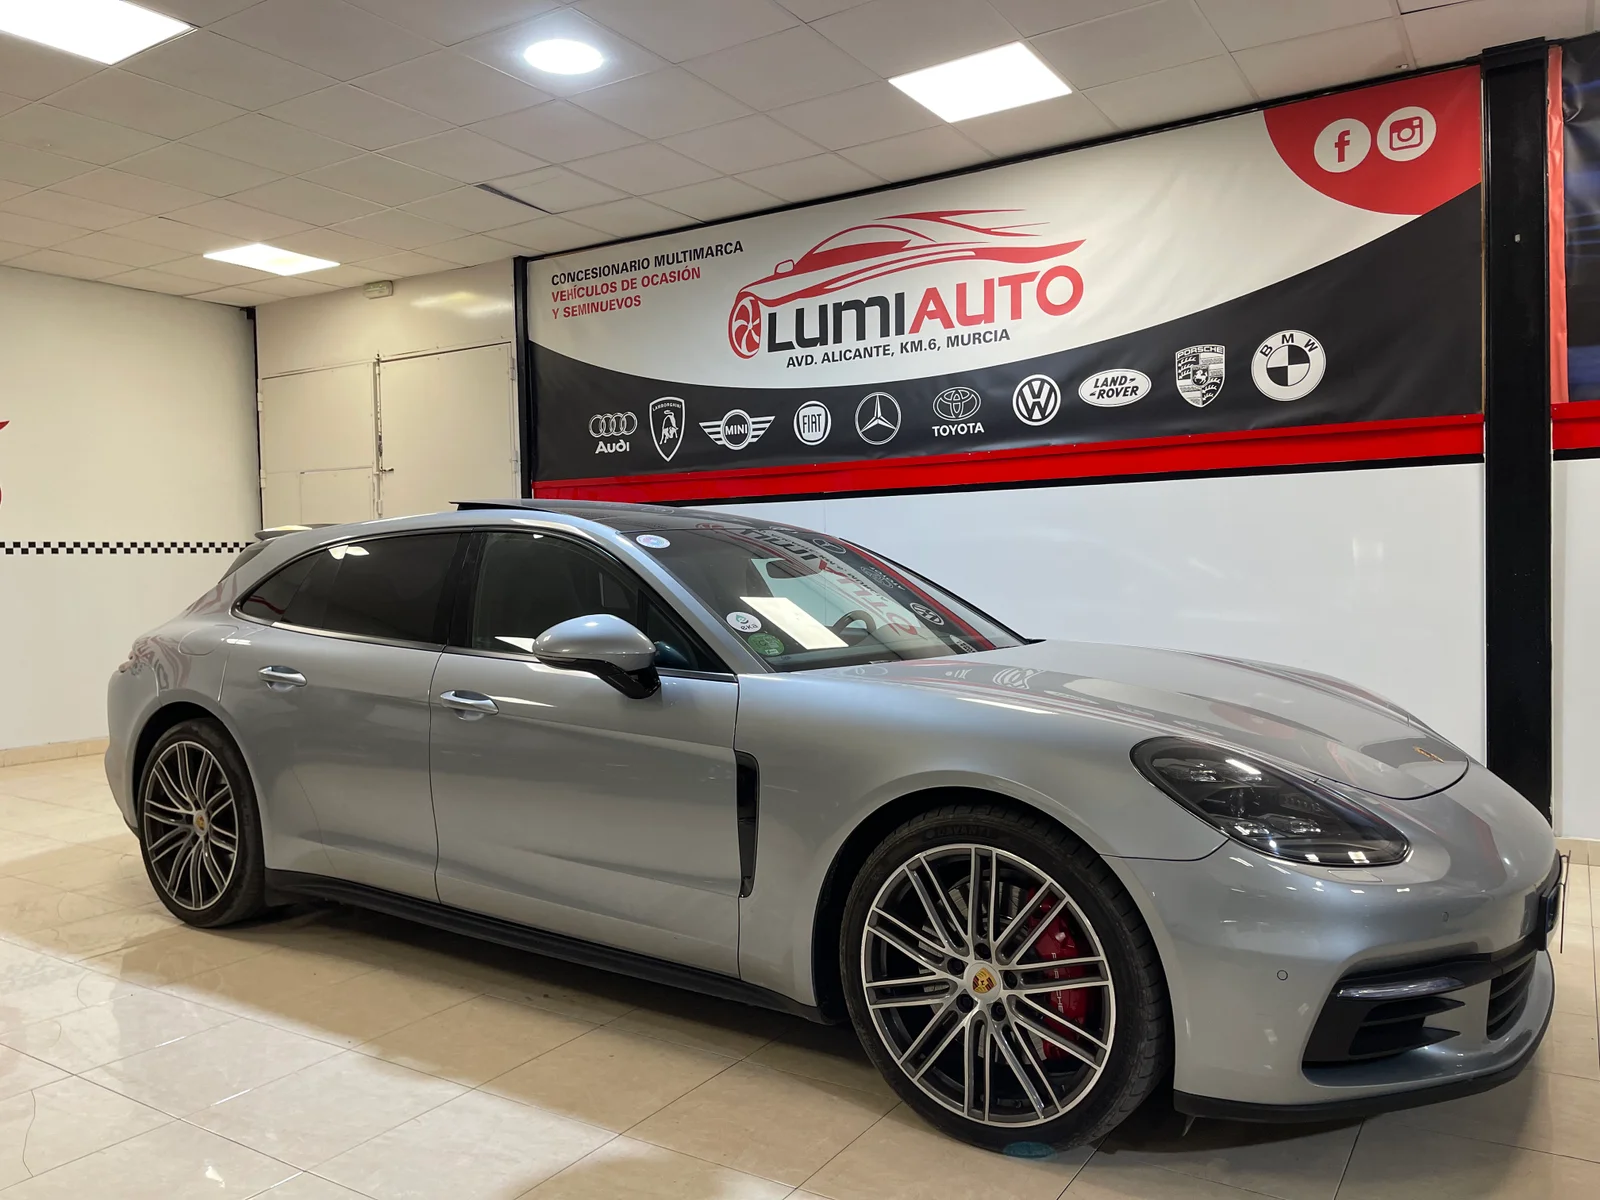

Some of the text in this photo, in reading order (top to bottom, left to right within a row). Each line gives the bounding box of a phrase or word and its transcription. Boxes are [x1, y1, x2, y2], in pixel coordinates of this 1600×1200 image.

[551, 240, 743, 286] CONCESIONARIO MULTIMARCA
[551, 264, 700, 303] VEHÍCULOS DE OCASIÓN
[552, 294, 641, 320] Y SEMINUEVOS
[786, 355, 818, 369] AVD.
[821, 345, 895, 364] ALICANTE,
[946, 328, 1011, 349] MURCIA
[1177, 345, 1224, 359] PORSCHE
[1093, 375, 1127, 389] LAND
[1096, 385, 1139, 400] ROVER
[725, 424, 748, 436] MINI
[802, 413, 822, 434] FIAT
[932, 422, 984, 437] TOYOTA
[595, 439, 630, 454] Audi
